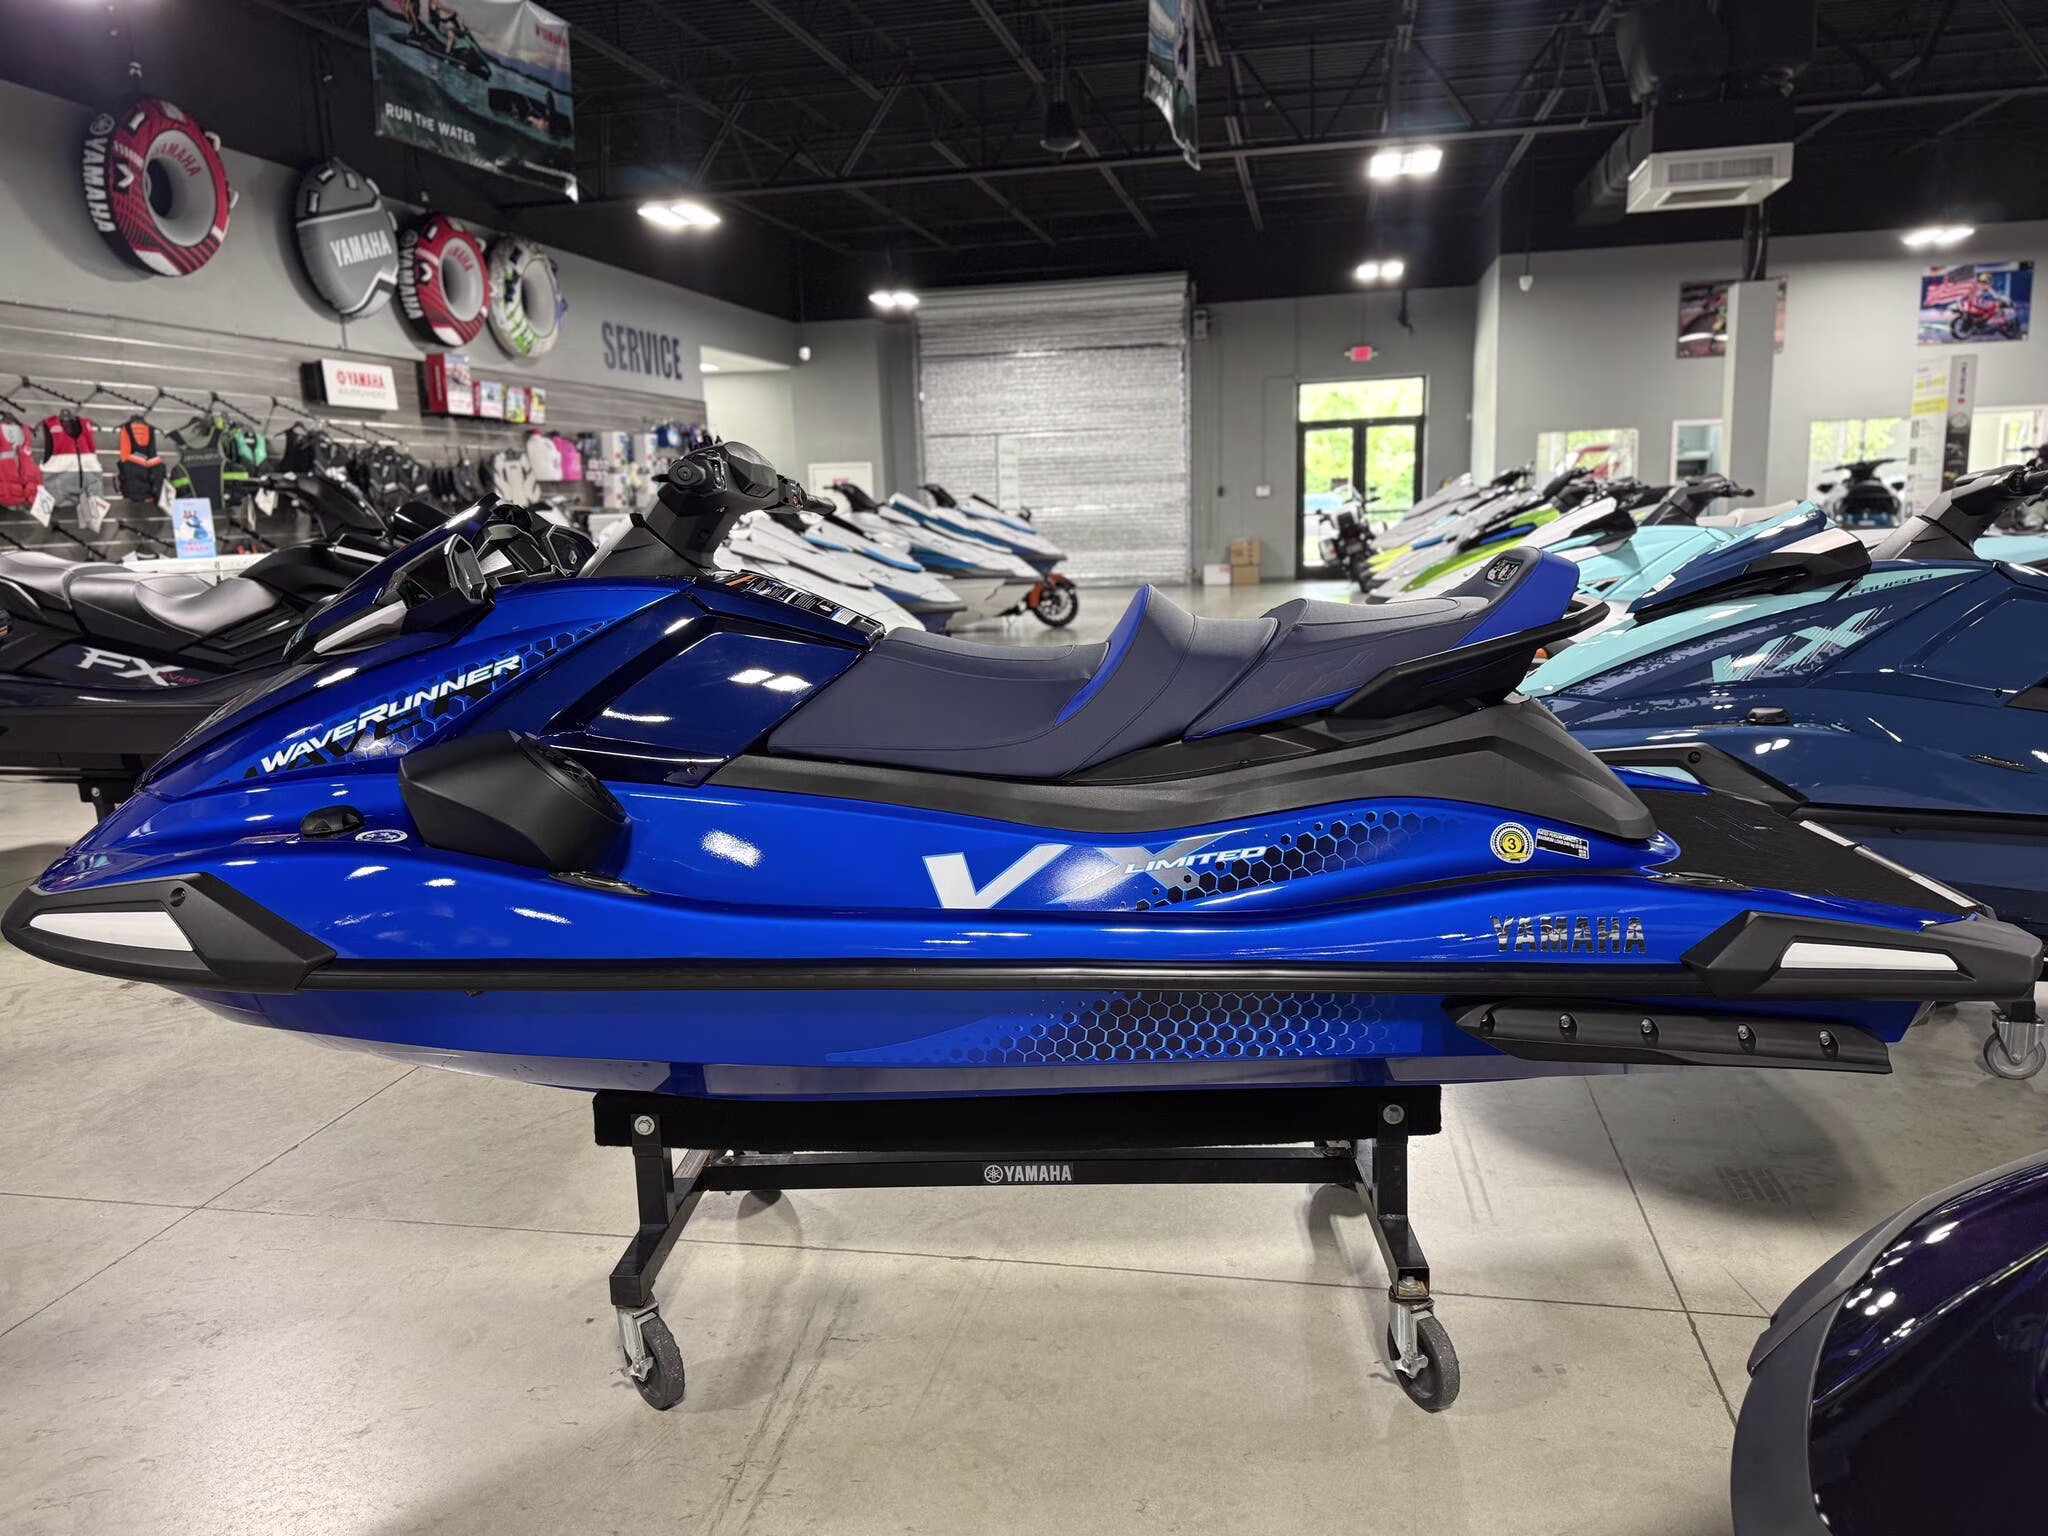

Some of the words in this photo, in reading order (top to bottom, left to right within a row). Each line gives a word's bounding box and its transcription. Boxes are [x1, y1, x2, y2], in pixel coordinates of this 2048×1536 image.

[385, 103, 412, 123] RUN
[414, 112, 434, 132] THE
[438, 121, 476, 145] WATER
[82, 137, 116, 232] YAMAHA
[329, 230, 393, 268] YAMAHA
[601, 320, 683, 380] SERVICE
[347, 370, 385, 389] YAMAHA
[1847, 572, 1934, 597] CRUISER
[1711, 606, 1893, 684] VX
[77, 646, 184, 686] FX
[261, 655, 521, 773] WAVERUNNER
[1125, 845, 1267, 874] LIMITED
[1507, 837, 1517, 850] 3
[922, 831, 1234, 909] VX
[1489, 915, 1647, 954] YAMAHA
[1003, 1164, 1072, 1182] YAMAHA
